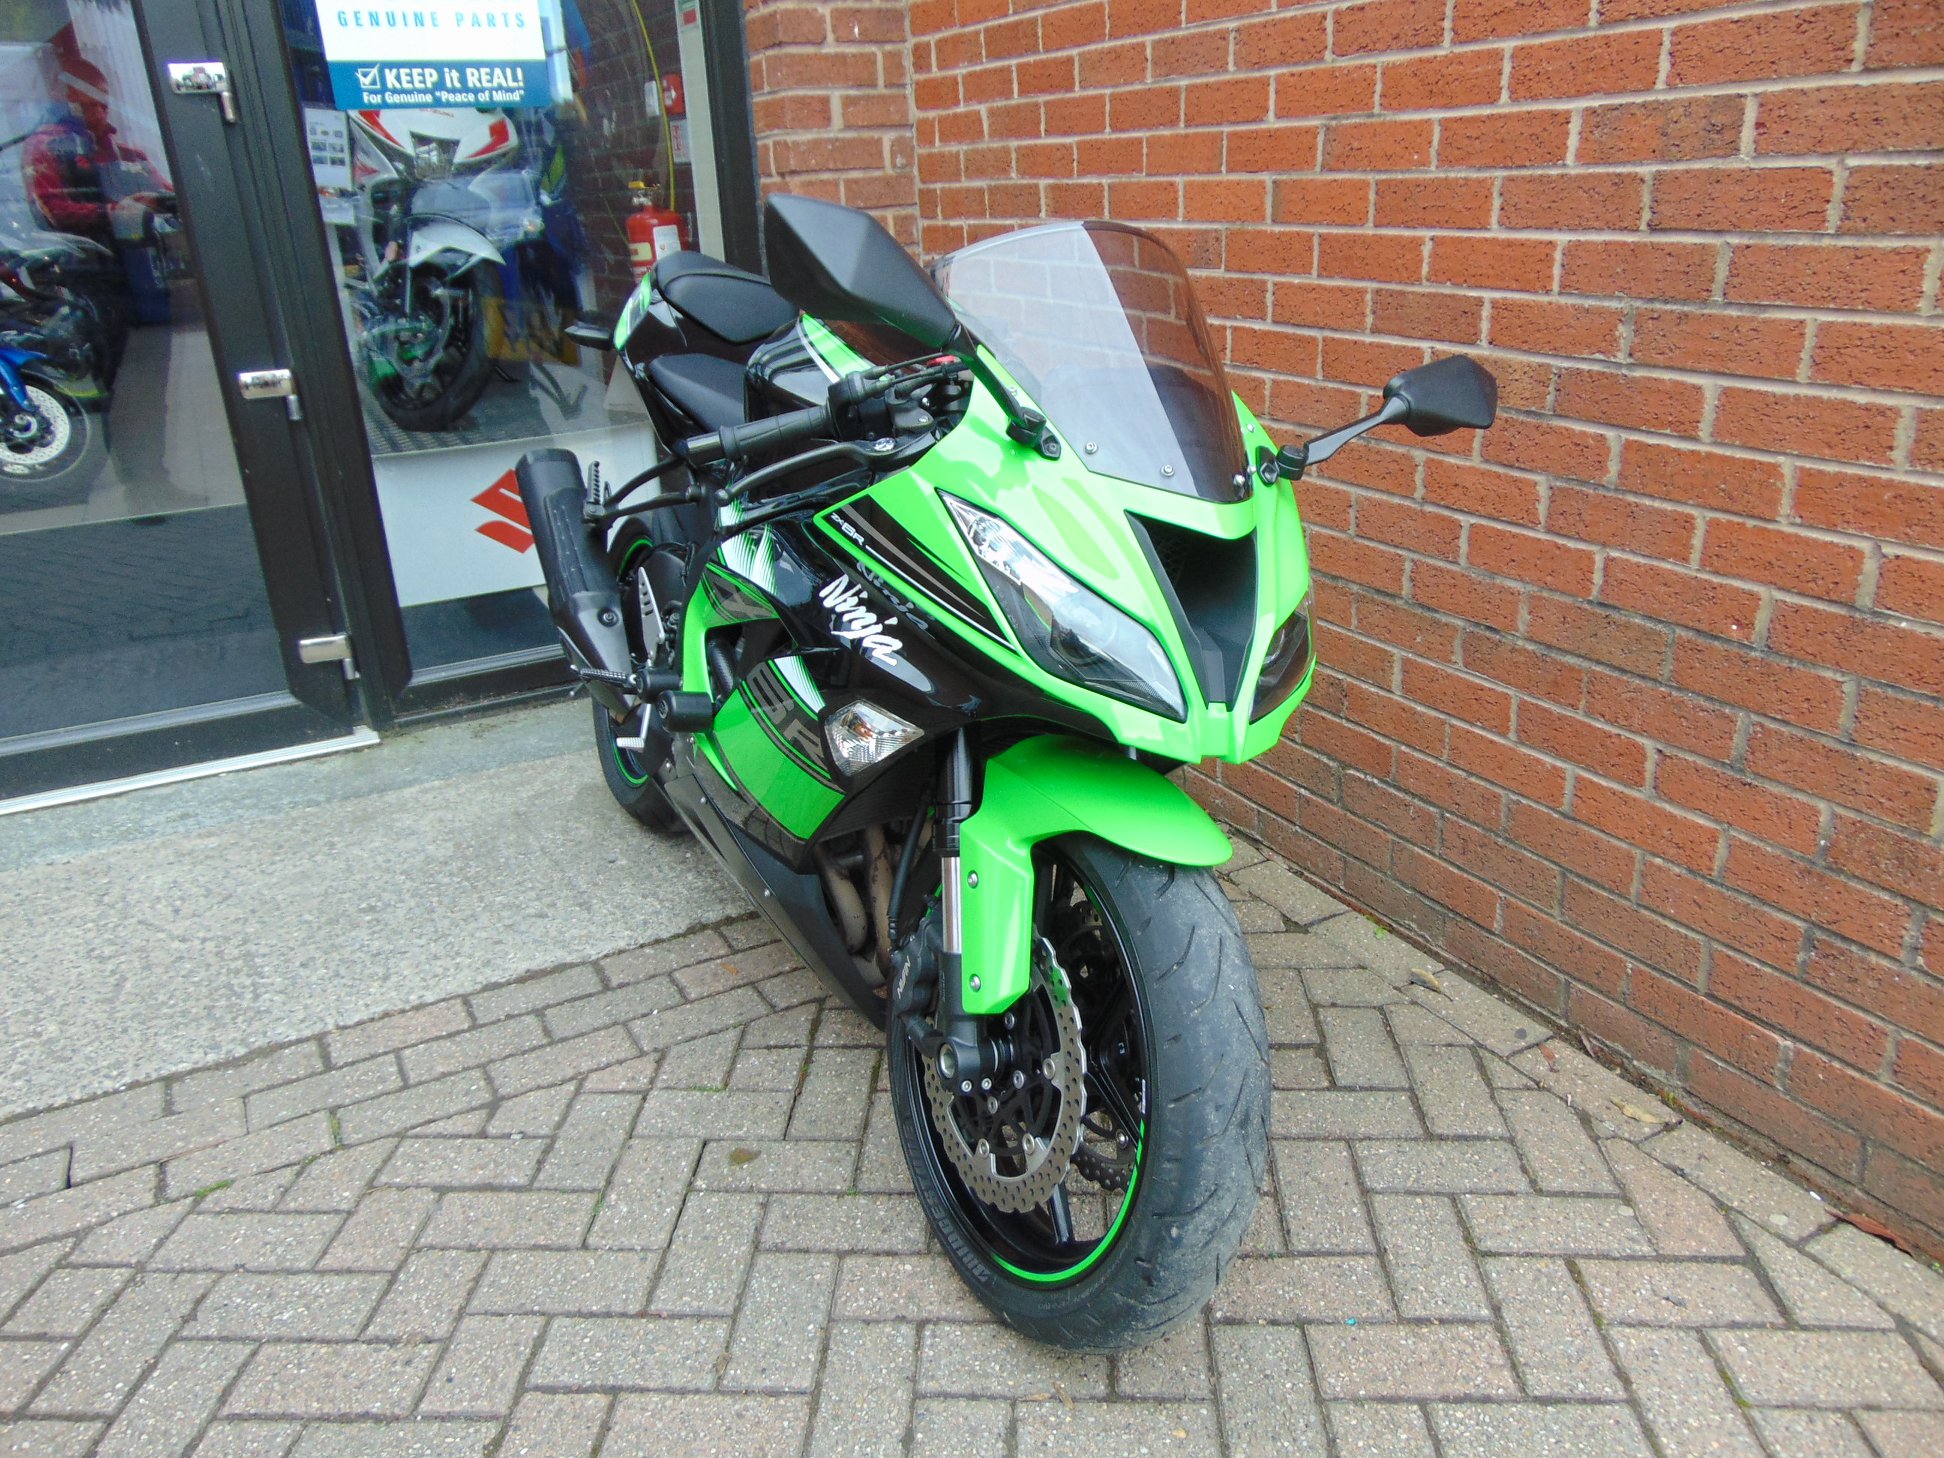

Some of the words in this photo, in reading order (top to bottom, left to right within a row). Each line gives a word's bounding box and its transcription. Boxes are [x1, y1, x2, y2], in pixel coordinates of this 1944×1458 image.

[337, 10, 440, 28] GENUINE
[455, 11, 525, 28] PARTS
[384, 67, 439, 89] KEEP
[443, 66, 462, 88] it
[465, 66, 525, 87] REAL!
[362, 91, 381, 104] For
[385, 91, 433, 103] Genuine
[478, 90, 490, 101] of
[818, 573, 904, 667] Ninja
